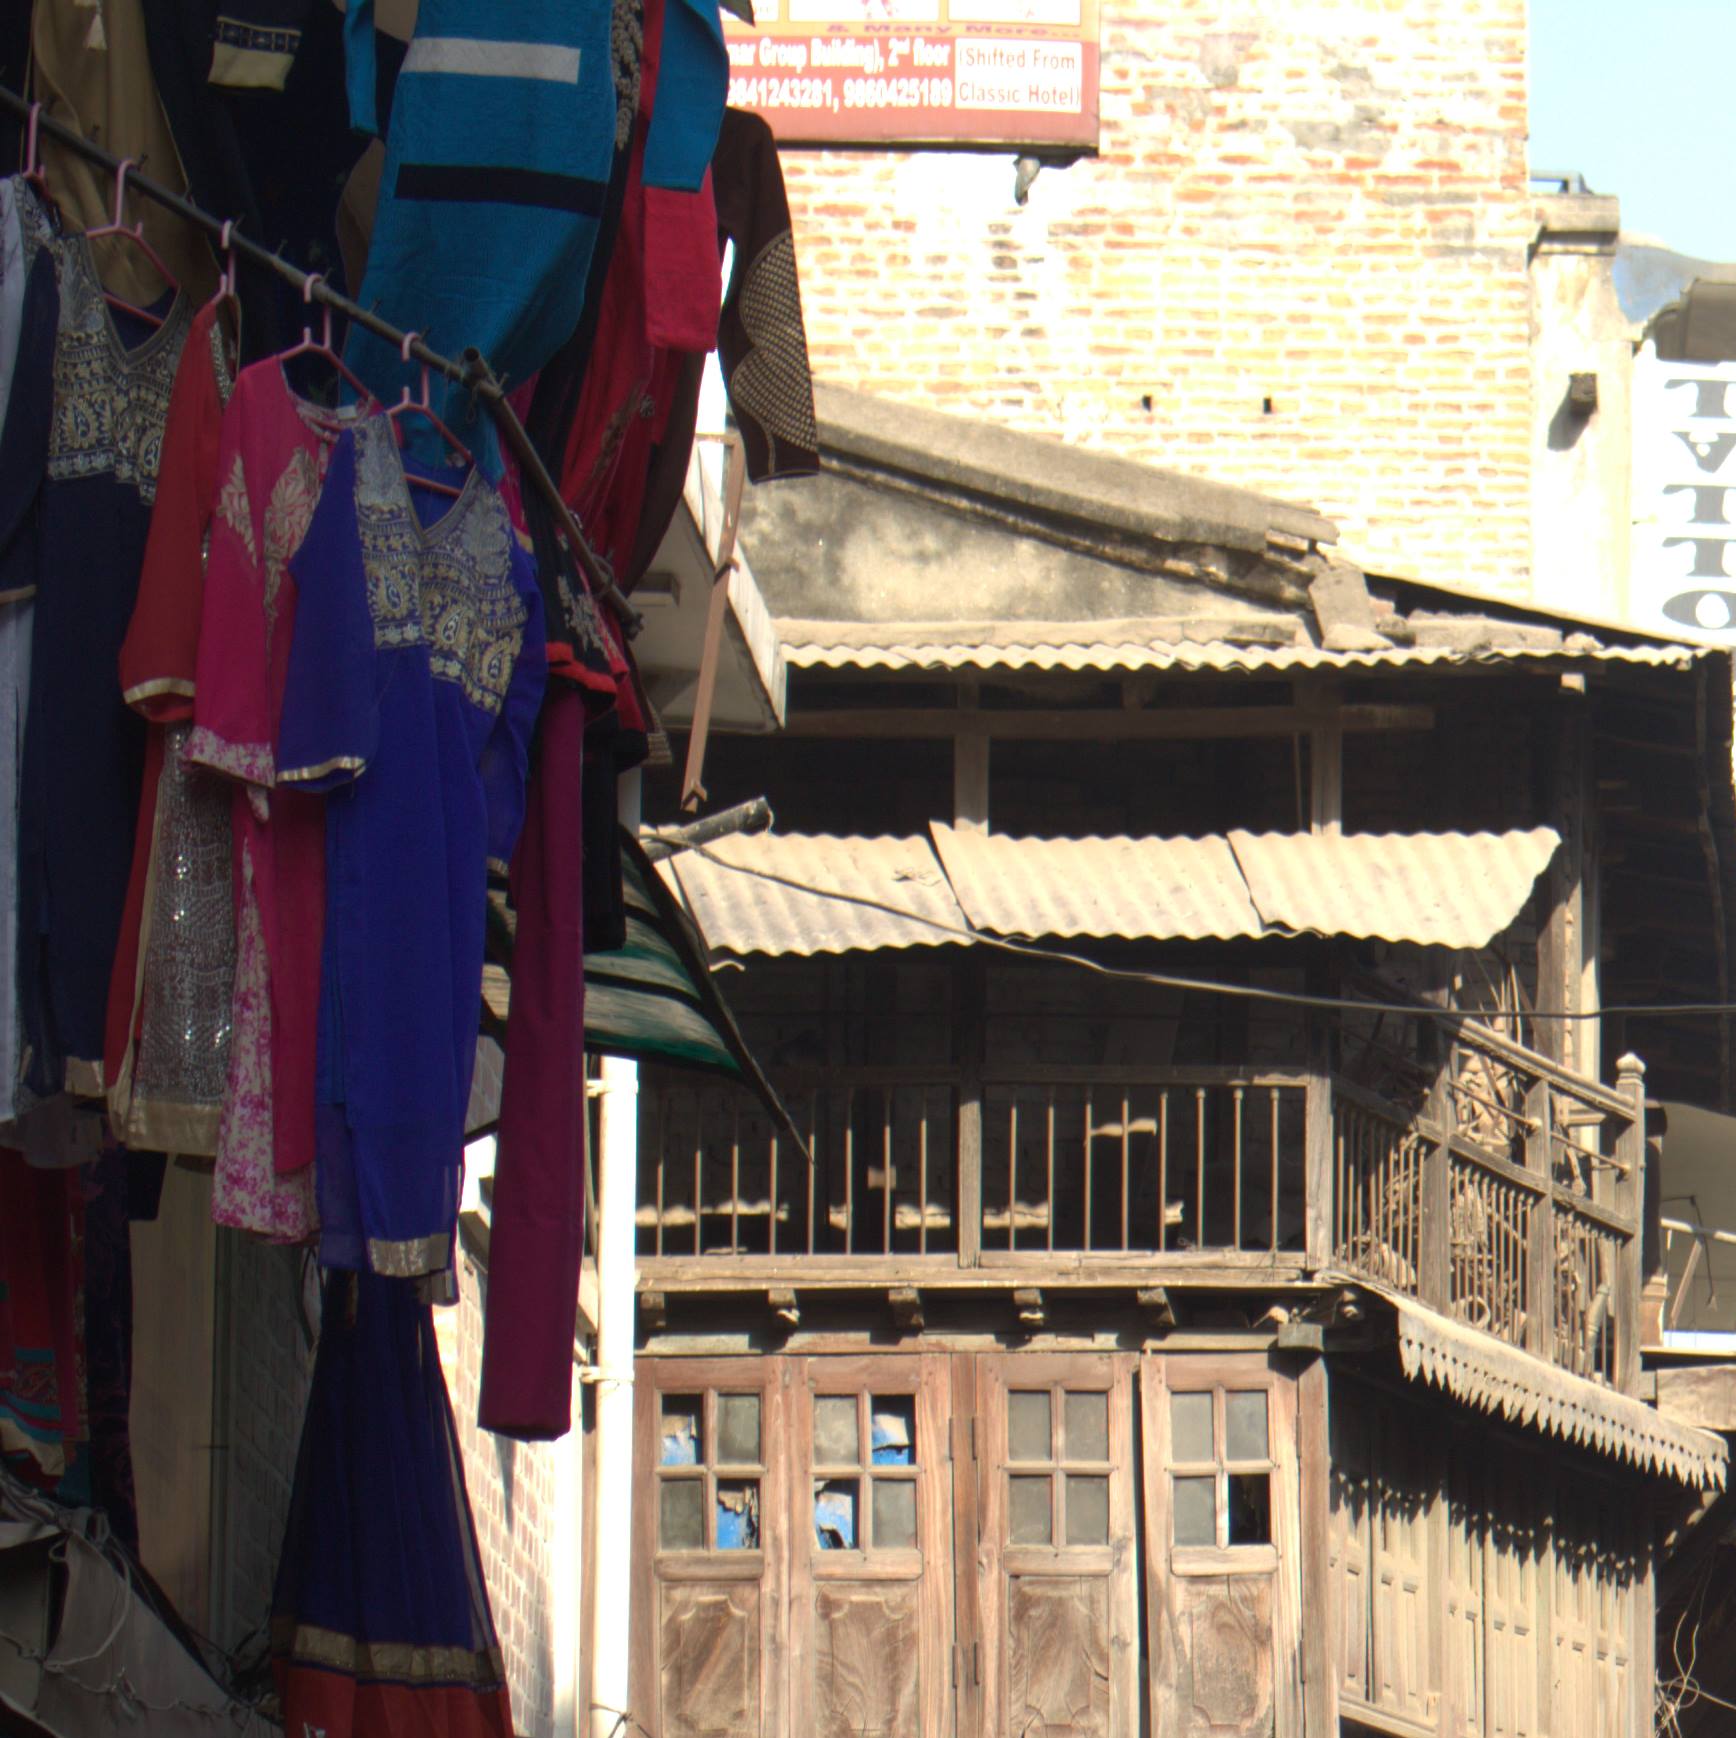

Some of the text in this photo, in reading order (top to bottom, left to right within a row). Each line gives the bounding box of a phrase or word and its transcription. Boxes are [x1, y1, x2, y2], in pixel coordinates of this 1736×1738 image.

[864, 24, 953, 35] Many
[759, 38, 807, 73] Group
[913, 38, 951, 67] floor
[1032, 50, 1076, 70] From
[959, 82, 1021, 104] Classic
